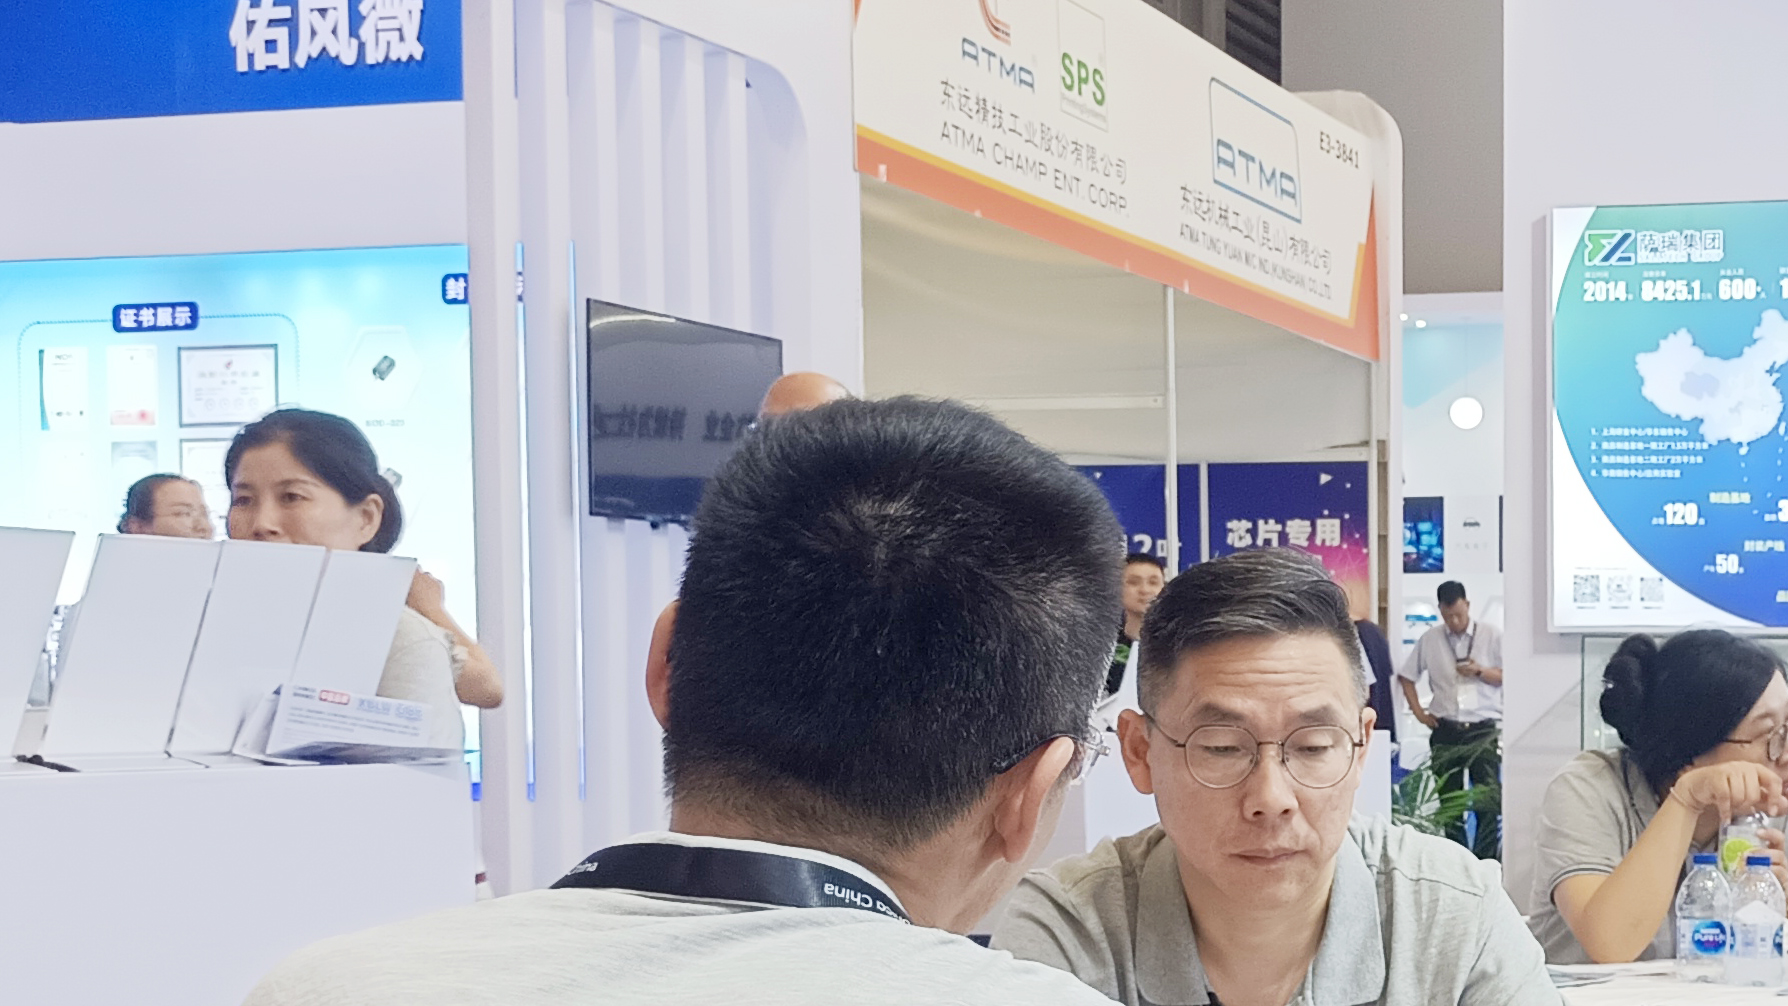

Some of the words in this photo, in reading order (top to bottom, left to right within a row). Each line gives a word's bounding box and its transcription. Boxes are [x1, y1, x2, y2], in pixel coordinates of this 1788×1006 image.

[229, 0, 424, 72] 佑风微
[961, 37, 1036, 94] ATMA
[1061, 52, 1106, 106] SPS
[941, 121, 987, 158] ATMA
[993, 142, 1048, 181] CHAMP
[1054, 168, 1085, 200] ENT.
[1088, 183, 1130, 218] CORP.
[1217, 138, 1298, 207] ATMA
[120, 306, 192, 328] 证书展示
[1226, 518, 1342, 549] 芯片专用
[823, 883, 873, 908] China
